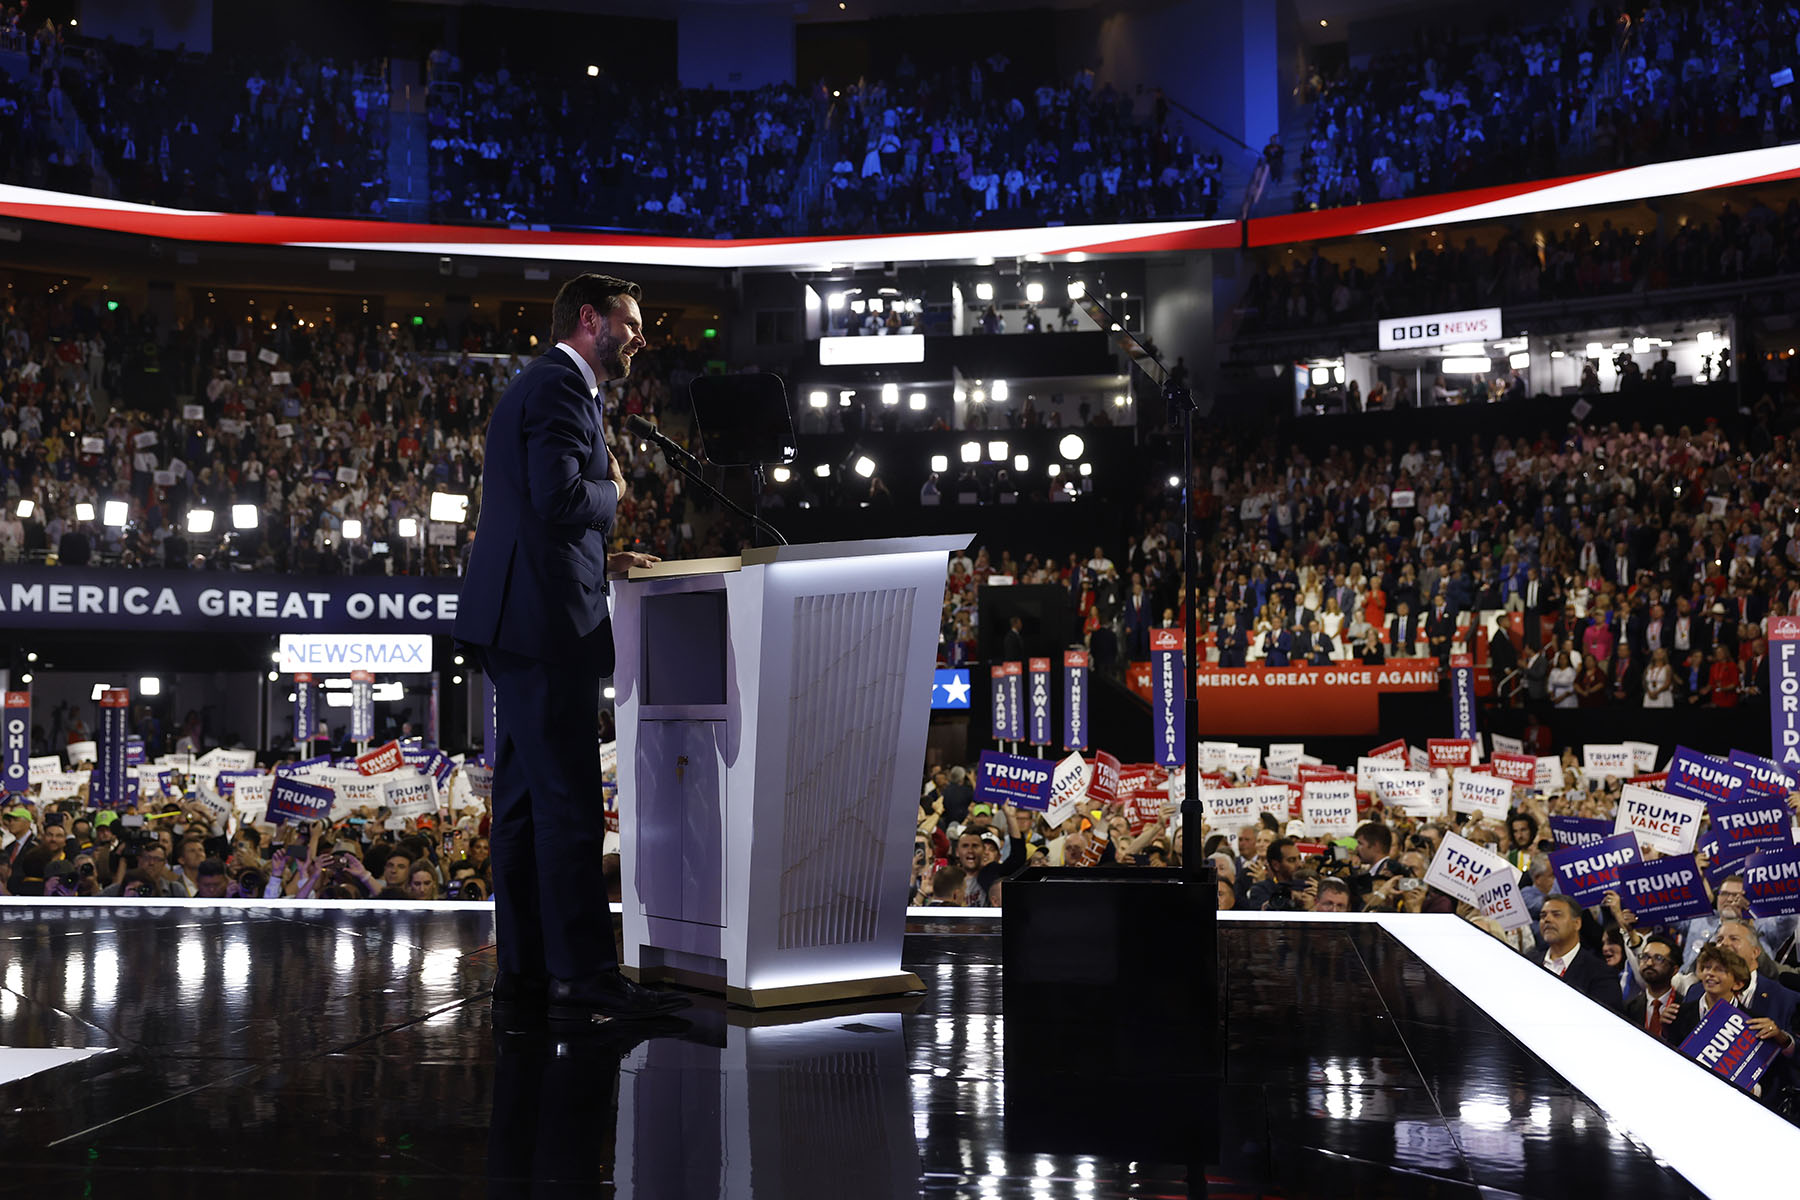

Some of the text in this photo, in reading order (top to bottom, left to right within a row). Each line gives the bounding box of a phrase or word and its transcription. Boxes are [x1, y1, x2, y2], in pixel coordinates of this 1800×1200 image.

[1393, 319, 1488, 340] BBC NEWS
[0, 583, 459, 620] MERICA GREAT ONCE
[288, 643, 423, 663] NEWSMAX
[1197, 670, 1439, 686] MERICA GREAT ONCE AGAIN!
[996, 683, 1006, 730] IDAHO
[1033, 673, 1047, 739] HAWAII
[1071, 668, 1081, 745] MINNESOTA
[1162, 652, 1176, 762] PENNSYLVANIA
[1457, 668, 1471, 739] OKLAHOMA
[1780, 644, 1800, 763] FLORIDA
[8, 719, 24, 779] OHIO
[363, 748, 398, 770] TRUMP
[1431, 745, 1469, 753] TRUMP
[1589, 752, 1628, 760] TRUMP
[985, 762, 1048, 784] TRUMP
[1493, 759, 1533, 770] TRUMP
[1679, 758, 1742, 790] TRUMP
[388, 784, 431, 798] TRUMP
[990, 775, 1039, 795] VANCE
[1050, 765, 1082, 797] RUMP
[1378, 781, 1425, 790] TRUMP
[1459, 781, 1505, 796] TRUMP
[1682, 773, 1731, 798] VANCE
[276, 787, 328, 809] TRUMP
[393, 793, 428, 805] VANCE
[1049, 777, 1086, 808] VANCE
[1208, 797, 1253, 808] TRUMP
[1260, 794, 1285, 804] UMP
[1384, 788, 1420, 797] VANCE
[1461, 793, 1497, 805] VANCE
[1213, 806, 1249, 815] VANCE
[1308, 809, 1351, 817] TRUMP
[1627, 800, 1692, 825] TRUMP
[1717, 808, 1783, 830] TRUMP
[1630, 815, 1681, 836] VANCE
[1729, 823, 1781, 841] VANCE
[1553, 829, 1602, 846] TRUMP
[1560, 847, 1635, 879] TRUMP
[1747, 860, 1800, 884] TRUM
[1448, 863, 1478, 886] VAN
[1626, 870, 1693, 895] TRUMP
[1636, 886, 1692, 907] VANCE
[1696, 1014, 1745, 1069] TRUMP
[1714, 1030, 1757, 1075] VANCE
